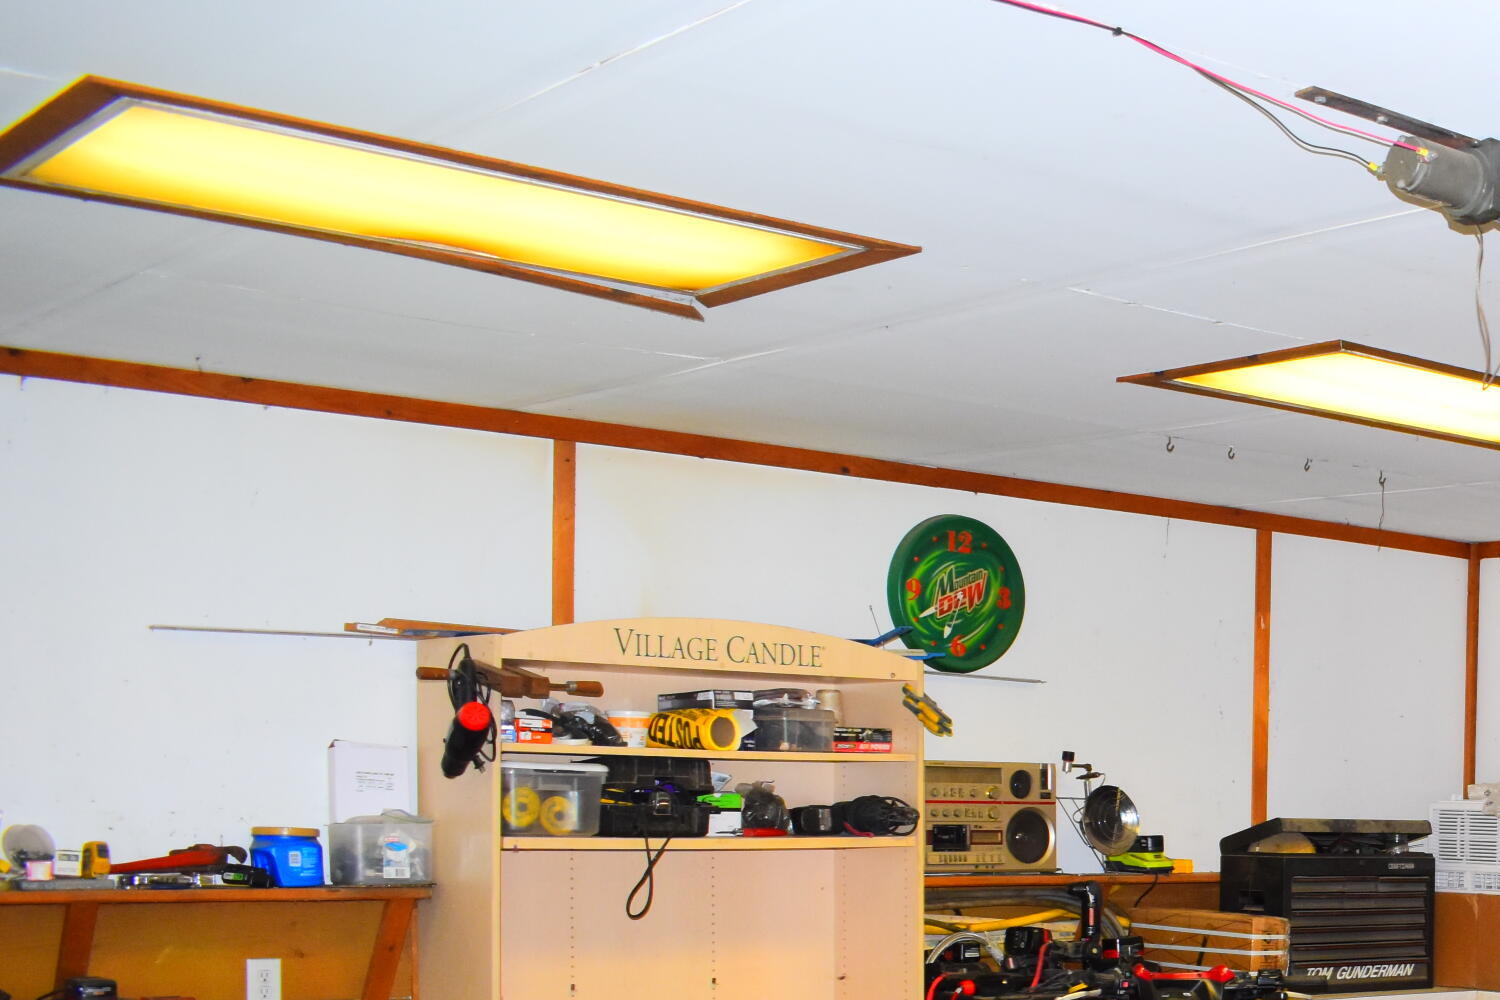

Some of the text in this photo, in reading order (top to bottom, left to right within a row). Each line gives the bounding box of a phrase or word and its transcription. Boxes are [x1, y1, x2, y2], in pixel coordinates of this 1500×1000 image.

[948, 530, 973, 554] 12
[905, 577, 921, 601] 9
[997, 586, 1012, 610] 3
[614, 627, 718, 662] VILLAGE
[950, 634, 967, 657] 6
[1337, 963, 1415, 980] GUNDERMAN
